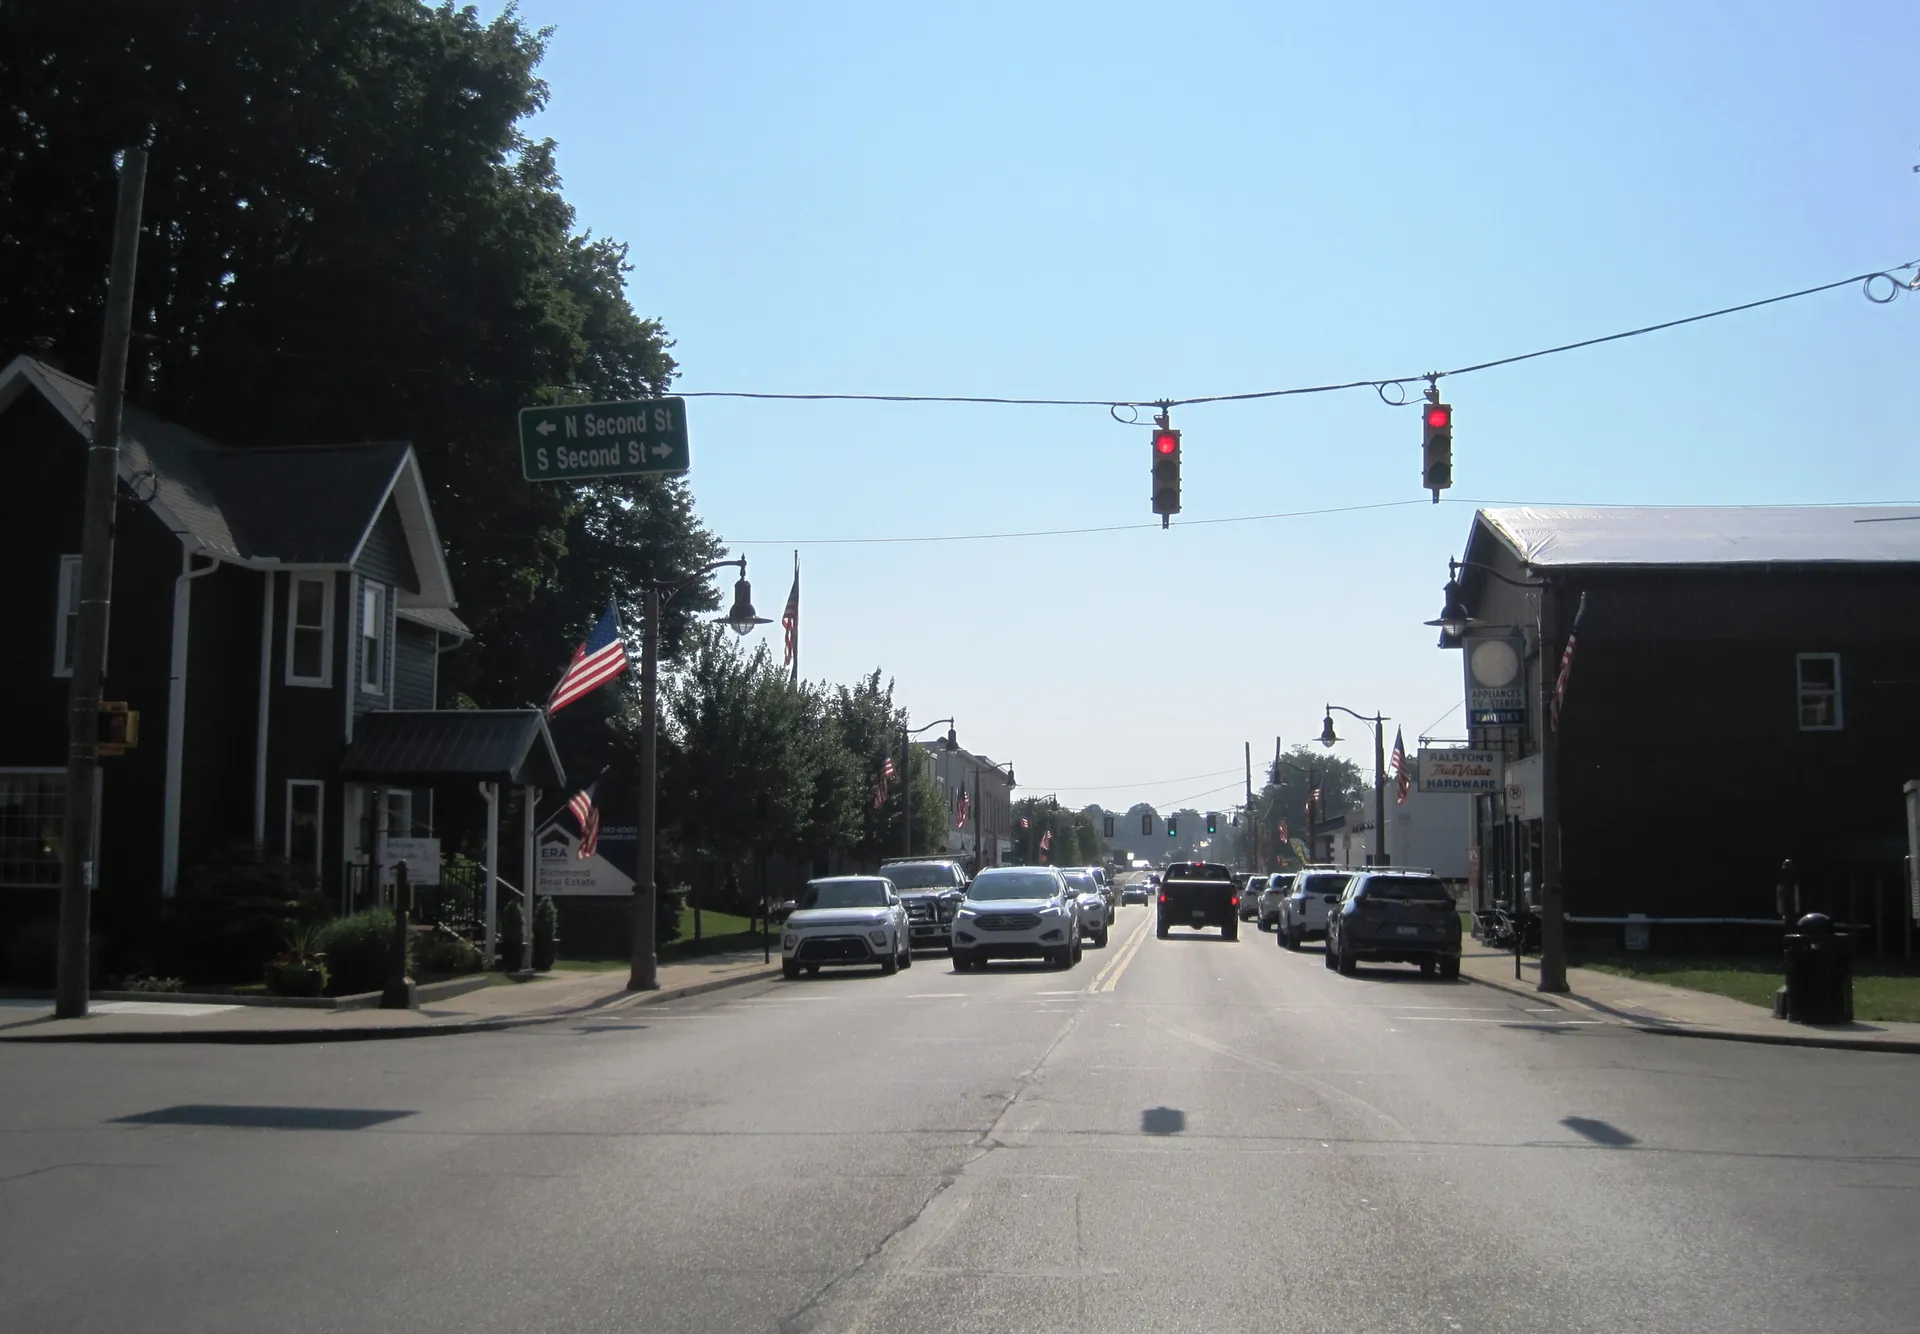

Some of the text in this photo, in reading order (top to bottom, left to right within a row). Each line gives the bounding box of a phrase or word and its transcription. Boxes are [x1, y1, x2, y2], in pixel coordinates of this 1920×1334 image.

[565, 408, 674, 438] N Second St
[537, 441, 646, 471] S Second St
[1472, 688, 1521, 698] APPLIANCES
[1430, 753, 1493, 762] RALSTON'S
[1427, 779, 1496, 789] HARDWARE
[542, 848, 567, 858] ERA
[540, 868, 590, 877] Richmond
[540, 878, 596, 886] Real Estate
